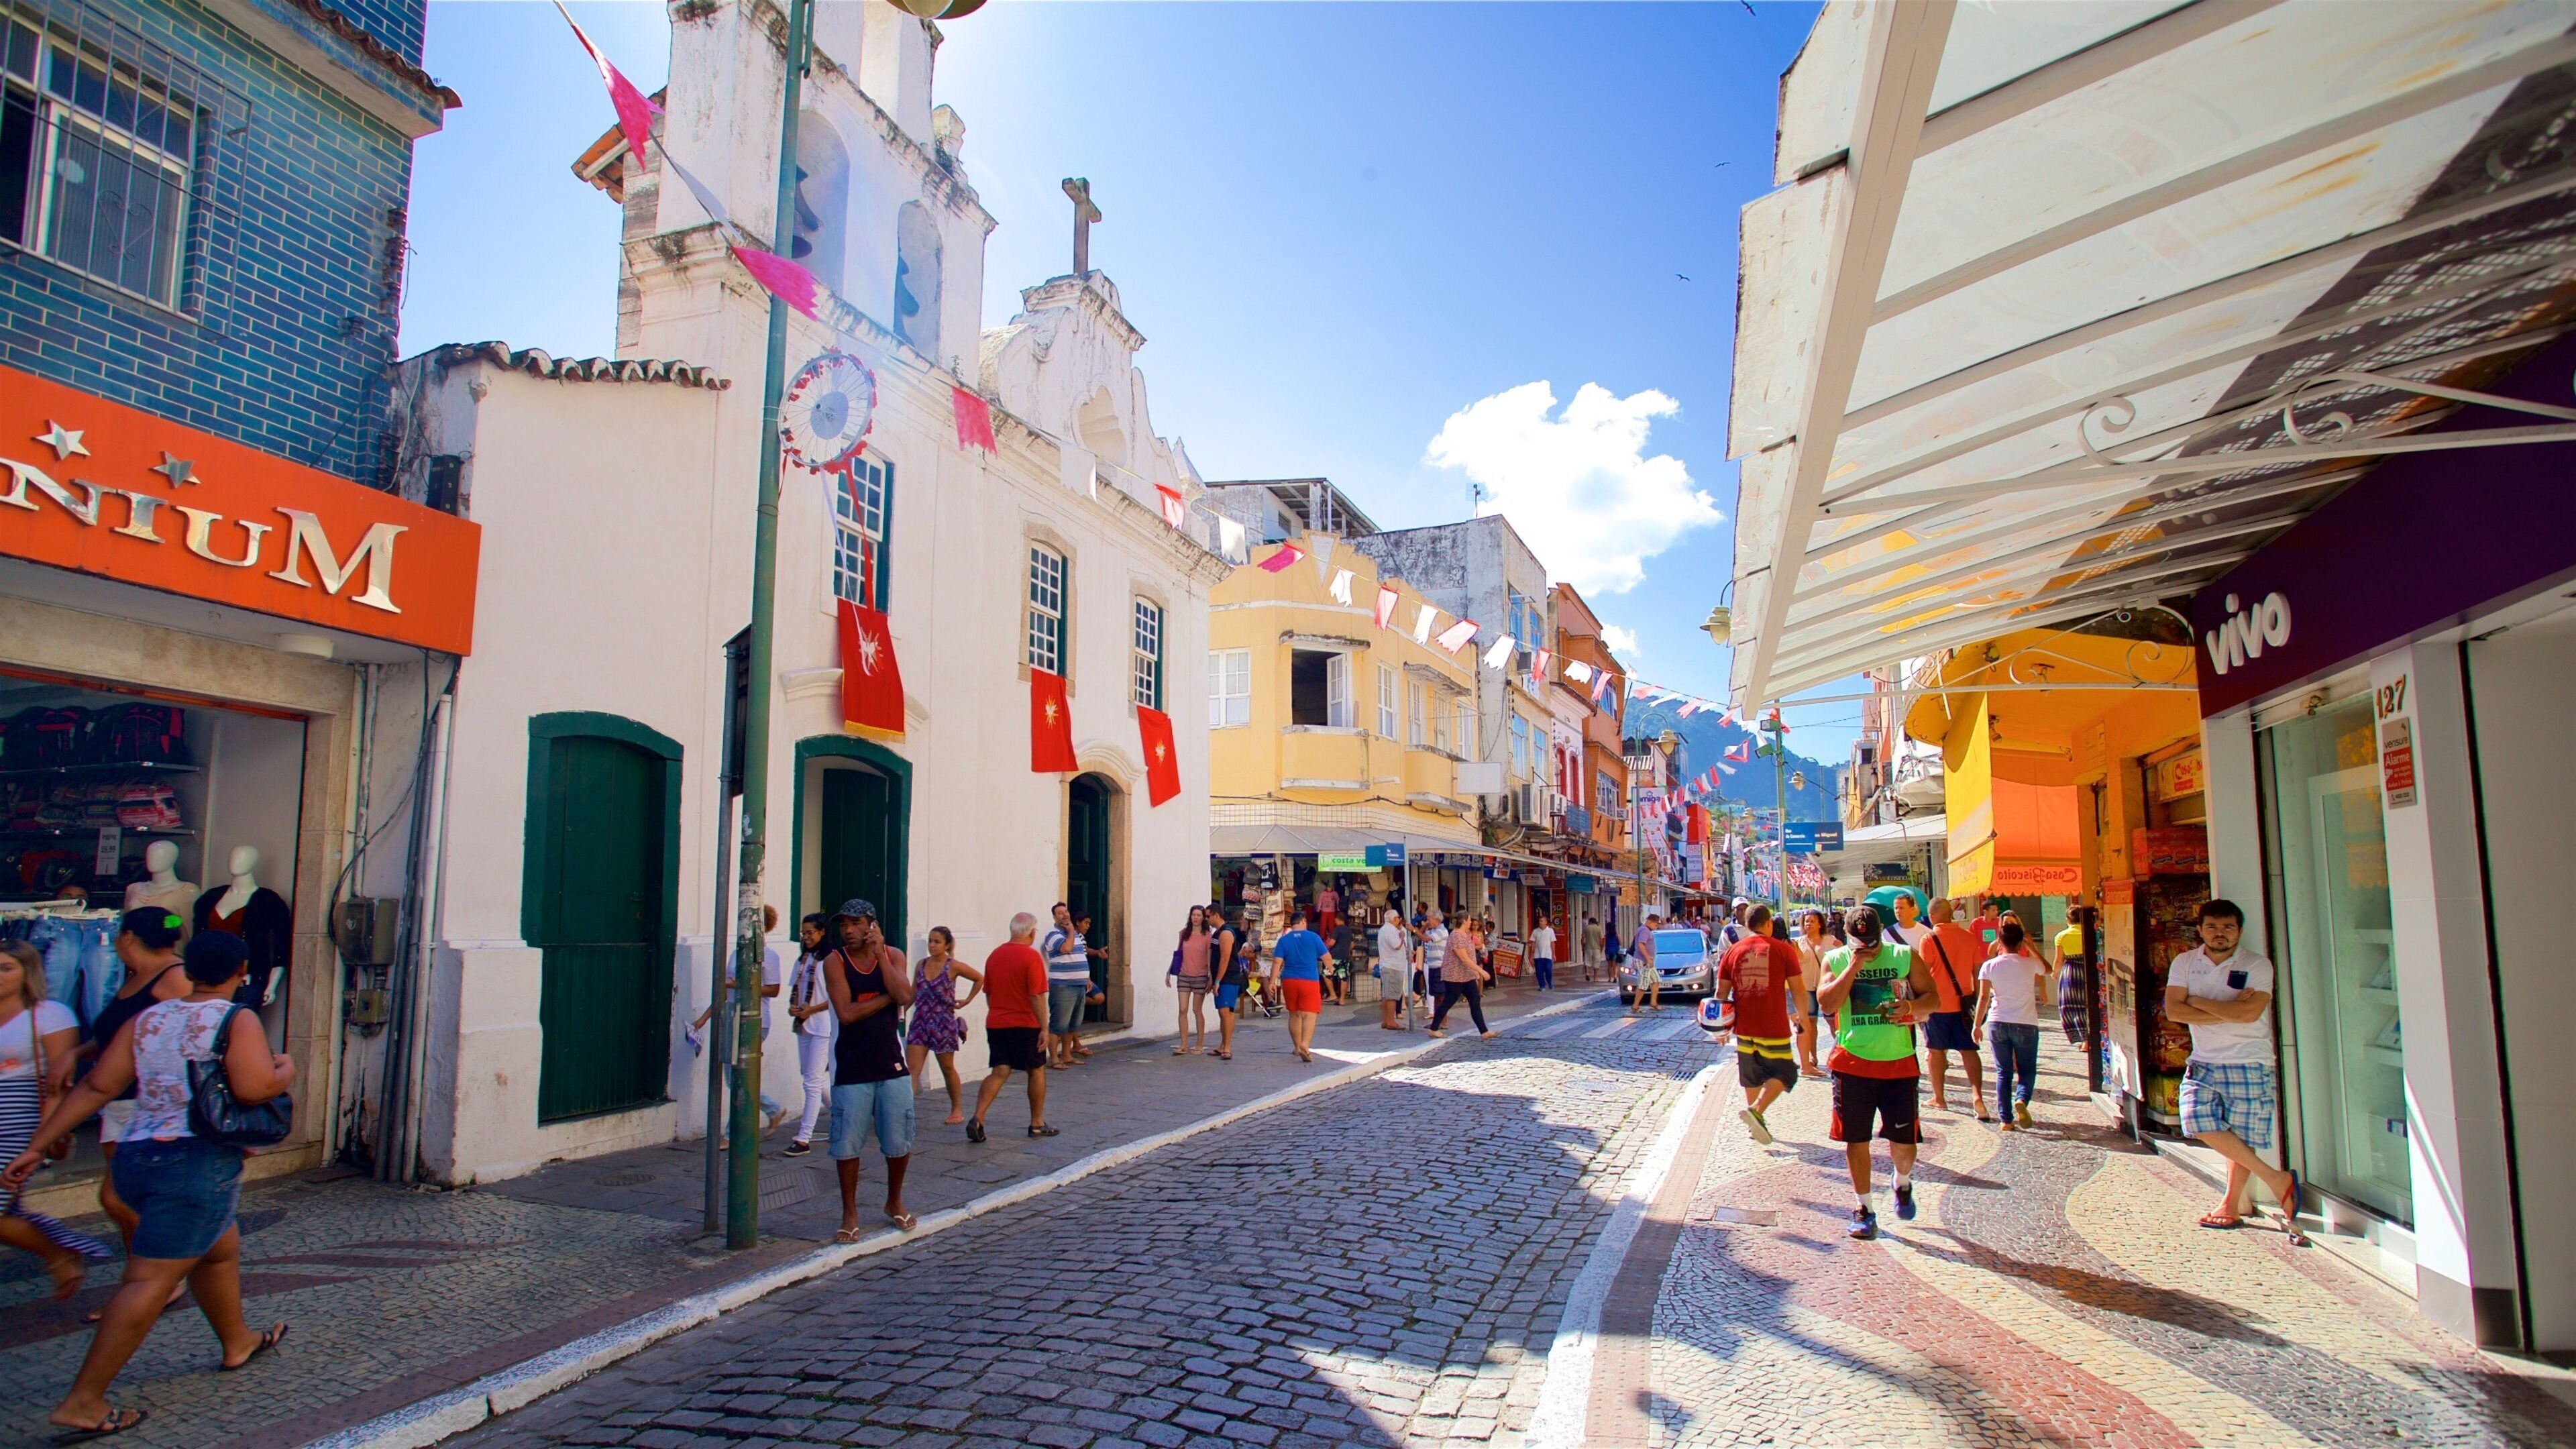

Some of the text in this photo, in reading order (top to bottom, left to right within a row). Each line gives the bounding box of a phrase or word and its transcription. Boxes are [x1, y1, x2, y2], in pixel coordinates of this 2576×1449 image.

[0, 458, 409, 613] NIUM
[2206, 591, 2291, 675] vivo
[2376, 674, 2406, 719] 127
[2385, 753, 2410, 767] Alarme
[1500, 965, 1516, 976] 80%
[1856, 968, 1898, 979] SSEIOS
